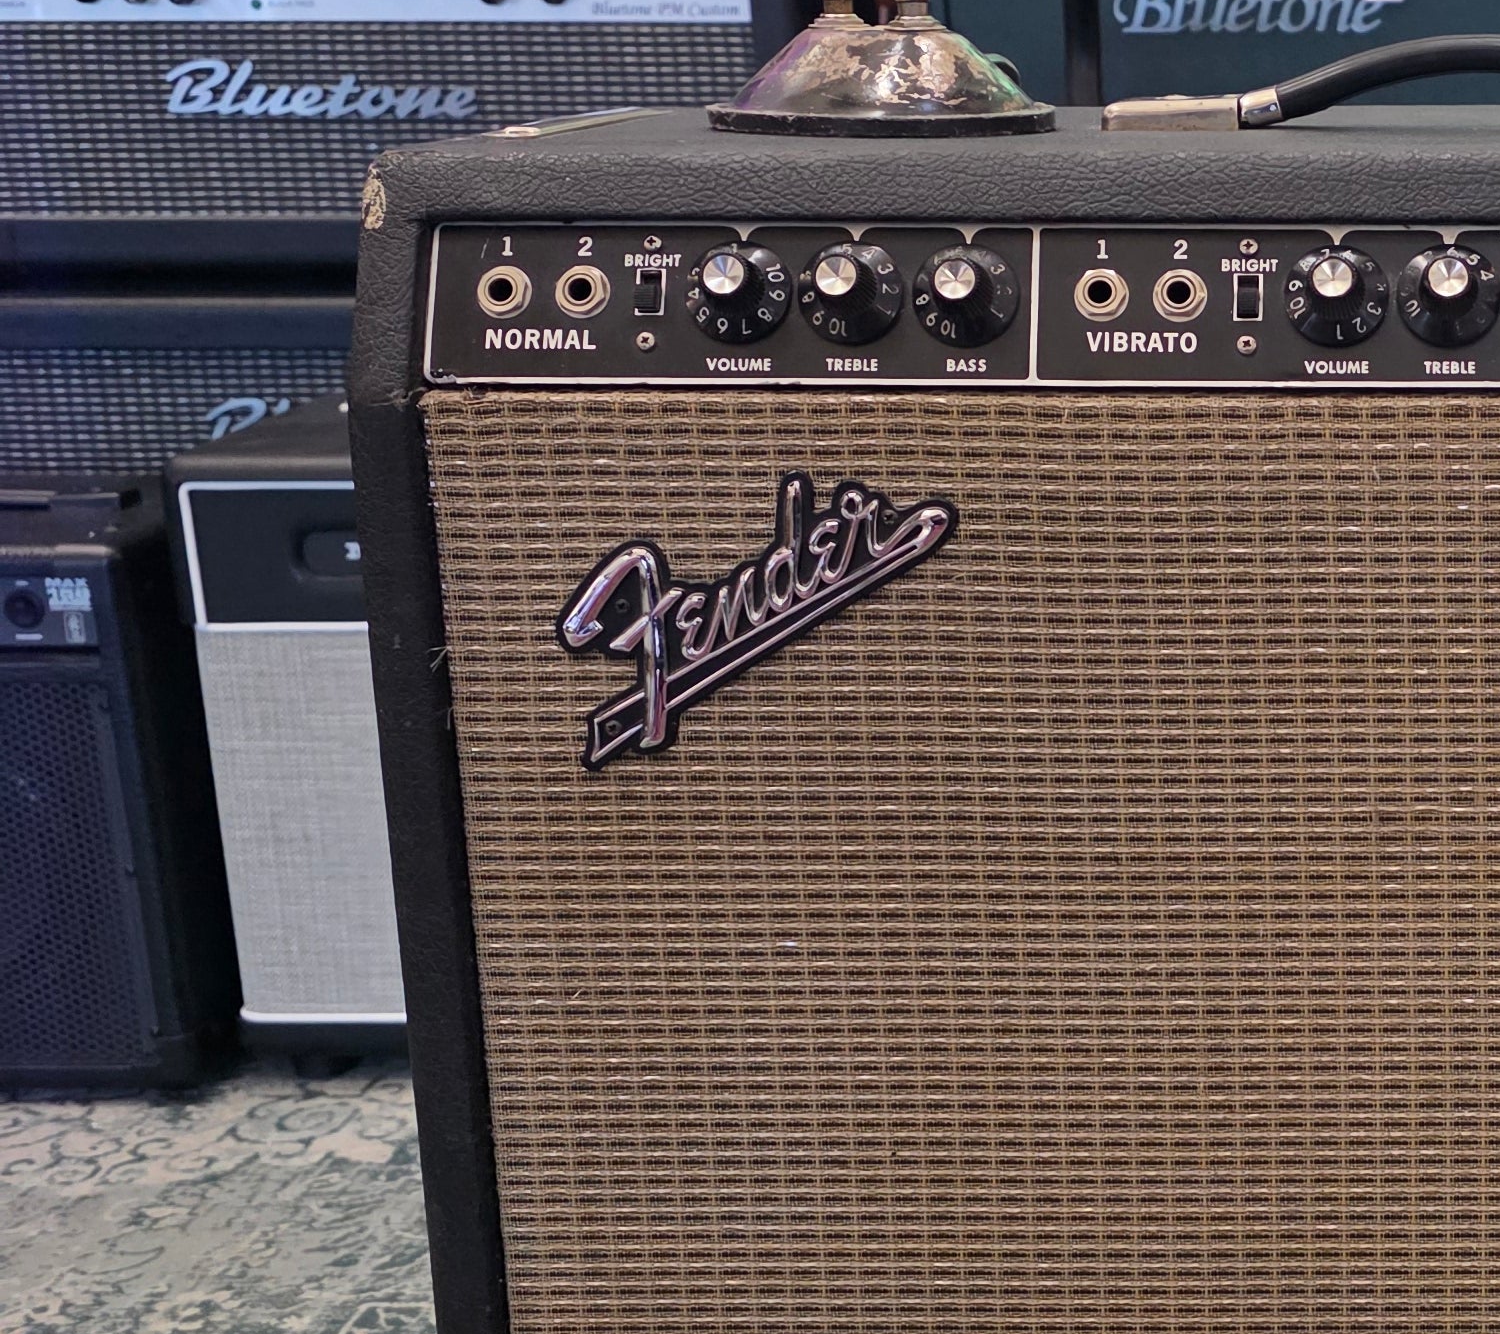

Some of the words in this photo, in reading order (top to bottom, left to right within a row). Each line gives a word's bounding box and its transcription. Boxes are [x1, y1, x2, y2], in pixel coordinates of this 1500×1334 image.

[165, 57, 477, 118] Bluetone
[501, 236, 514, 256] 1
[577, 236, 593, 257] 2
[862, 245, 876, 260] 4
[1096, 239, 1109, 259] 1
[1173, 239, 1188, 259] 2
[624, 254, 682, 267] BRIGHT
[1221, 259, 1279, 272] BRIGHT
[1466, 254, 1480, 266] 5
[766, 263, 785, 283] 10
[877, 263, 894, 275] 3
[990, 263, 1006, 275] 3
[1479, 270, 1495, 282] 4
[688, 287, 700, 299] 4
[881, 283, 899, 295] 2
[802, 291, 815, 303] 8
[915, 293, 930, 306] 8
[696, 307, 710, 323] 5
[757, 308, 773, 322] 8
[1289, 296, 1306, 320] 10
[1367, 302, 1382, 316] 3
[1405, 299, 1421, 318] 10
[828, 318, 847, 337] 10
[940, 320, 956, 339] 10
[1336, 324, 1344, 340] 1
[1351, 317, 1367, 334] 2
[484, 329, 597, 350] NORMAL
[1086, 331, 1198, 353] VIBRATO
[705, 357, 772, 371] VOLUME
[825, 358, 879, 372] TREBLE
[946, 359, 987, 372] BASS
[1304, 360, 1369, 374] VOLUME
[1423, 361, 1476, 374] TREBLE
[562, 477, 951, 765] Fender
